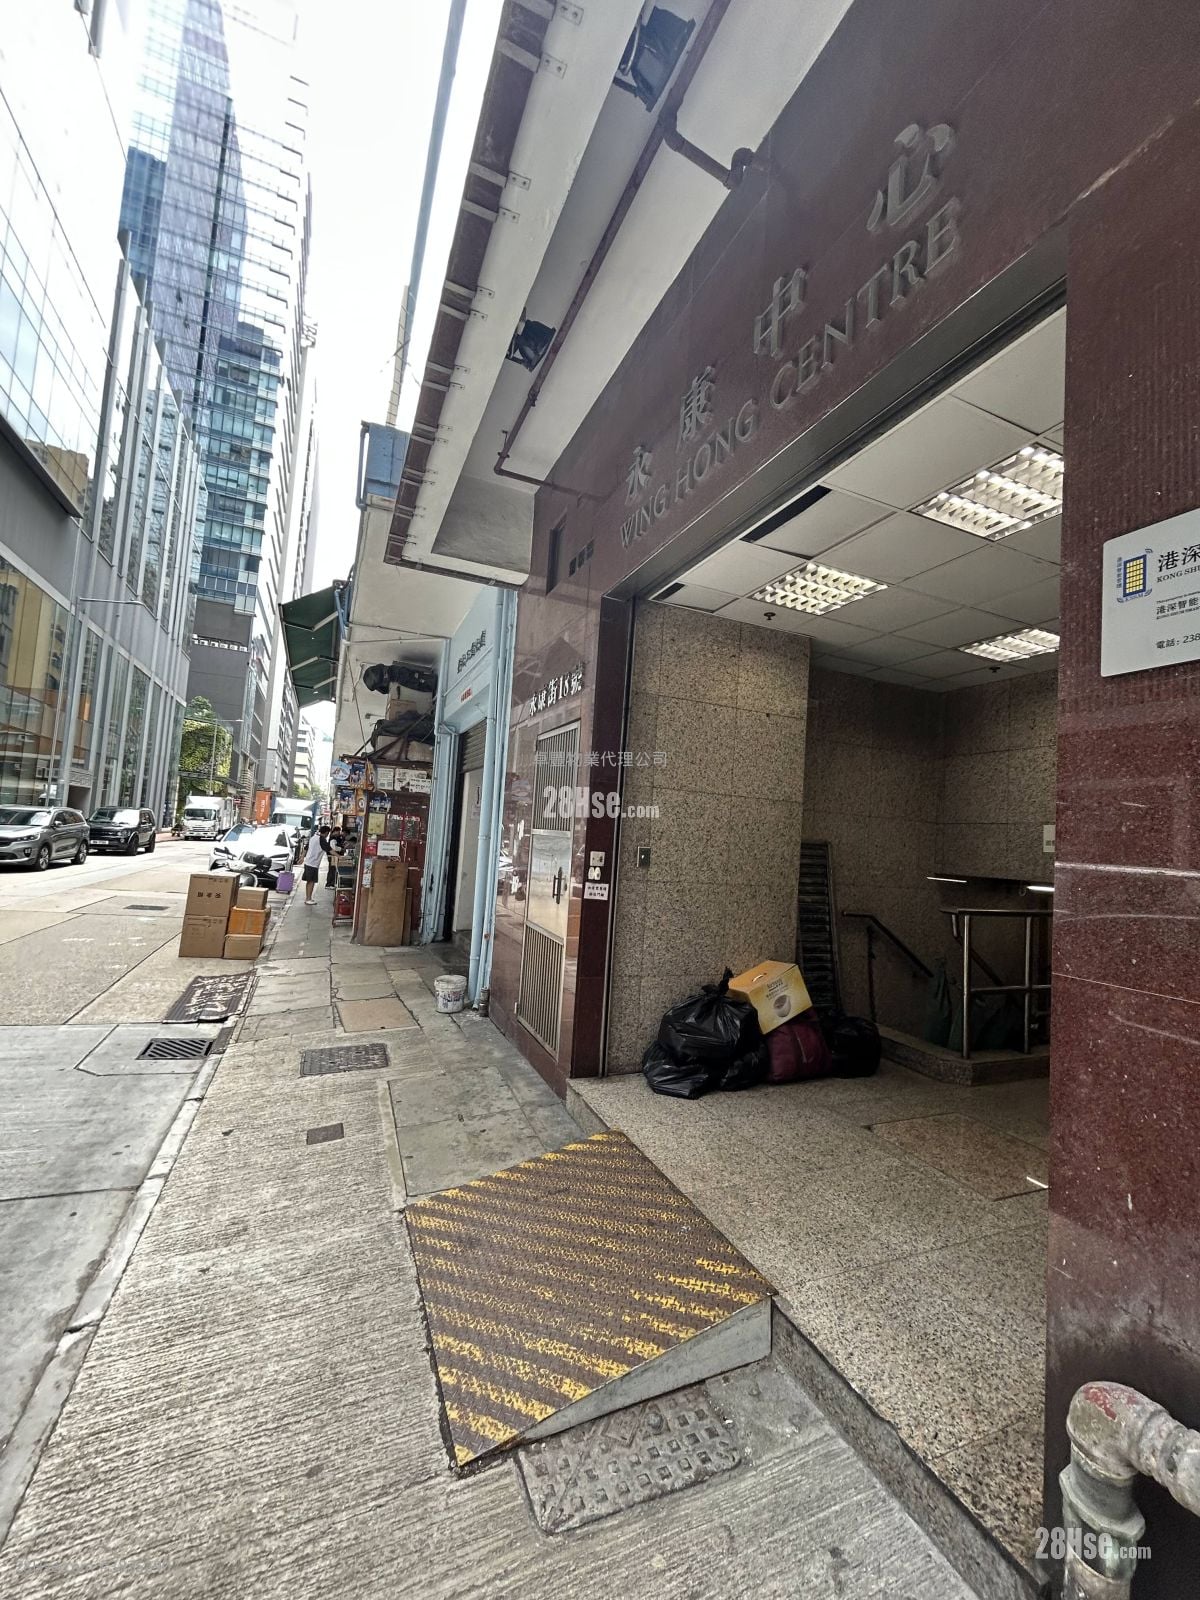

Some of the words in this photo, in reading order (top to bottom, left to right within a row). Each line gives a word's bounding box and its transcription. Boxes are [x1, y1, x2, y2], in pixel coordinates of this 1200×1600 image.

[620, 484, 668, 549] WING
[674, 398, 755, 503] HONG
[769, 197, 961, 409] CENTRE
[1158, 544, 1200, 572] 港深
[1156, 570, 1183, 583] KONG
